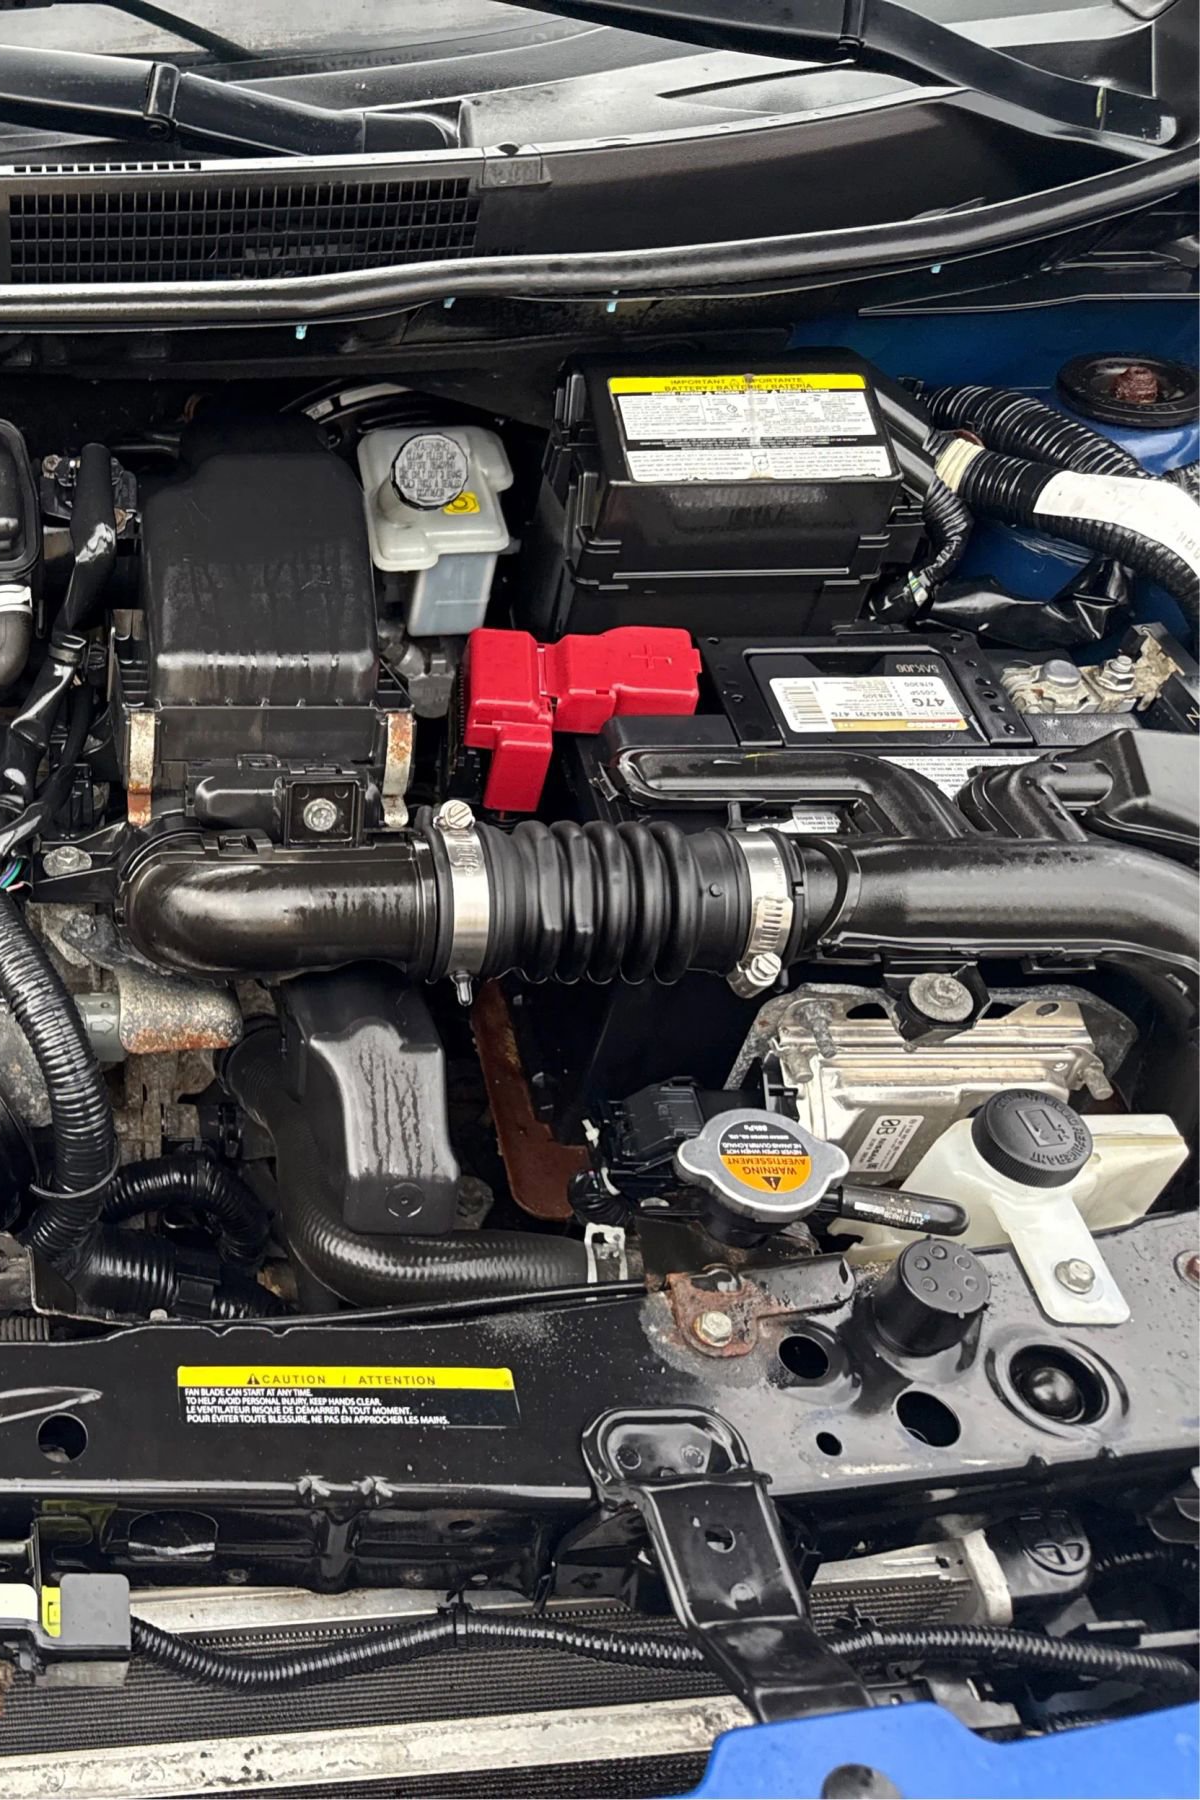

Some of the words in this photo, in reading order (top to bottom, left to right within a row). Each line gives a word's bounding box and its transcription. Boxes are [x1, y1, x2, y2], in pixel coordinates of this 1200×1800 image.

[912, 697, 945, 707] 47G
[727, 1157, 806, 1165] AVERTISSEMENT
[742, 1166, 797, 1175] WARNING
[262, 1375, 326, 1385] CAUTION
[358, 1375, 436, 1385] ATTENTION
[185, 1388, 199, 1397] FAN
[200, 1388, 224, 1397] BLADE
[225, 1388, 242, 1397] CAN
[243, 1388, 264, 1397] START
[267, 1388, 275, 1397] AT
[277, 1388, 292, 1397] ANY
[294, 1388, 313, 1397] TIME.
[186, 1397, 196, 1405] TO
[198, 1397, 216, 1405] HELP
[218, 1397, 241, 1405] AVOID
[242, 1397, 280, 1405] PERSONAL
[282, 1397, 308, 1406] INJURY,
[309, 1397, 327, 1405] KEEP
[328, 1397, 355, 1405] HANDS
[356, 1397, 382, 1405] CLEAR.
[186, 1406, 196, 1414] LE
[197, 1406, 250, 1414] VENTILATEUR
[252, 1406, 281, 1415] RISQUE
[283, 1406, 294, 1414] DE
[295, 1405, 340, 1414] DÉMARRER
[341, 1405, 349, 1414] À
[349, 1406, 371, 1415] TOUT
[372, 1406, 412, 1415] MOMENT.
[187, 1415, 210, 1423] POUR
[212, 1414, 239, 1423] ÉVITER
[240, 1415, 267, 1423] TOUTE
[268, 1415, 310, 1424] BLESSURE,
[311, 1415, 322, 1423] NE
[324, 1415, 339, 1423] PAS
[341, 1415, 353, 1423] EN
[354, 1415, 403, 1424] APPROCHER
[404, 1415, 419, 1424] LES
[420, 1415, 450, 1424] MAINS.
